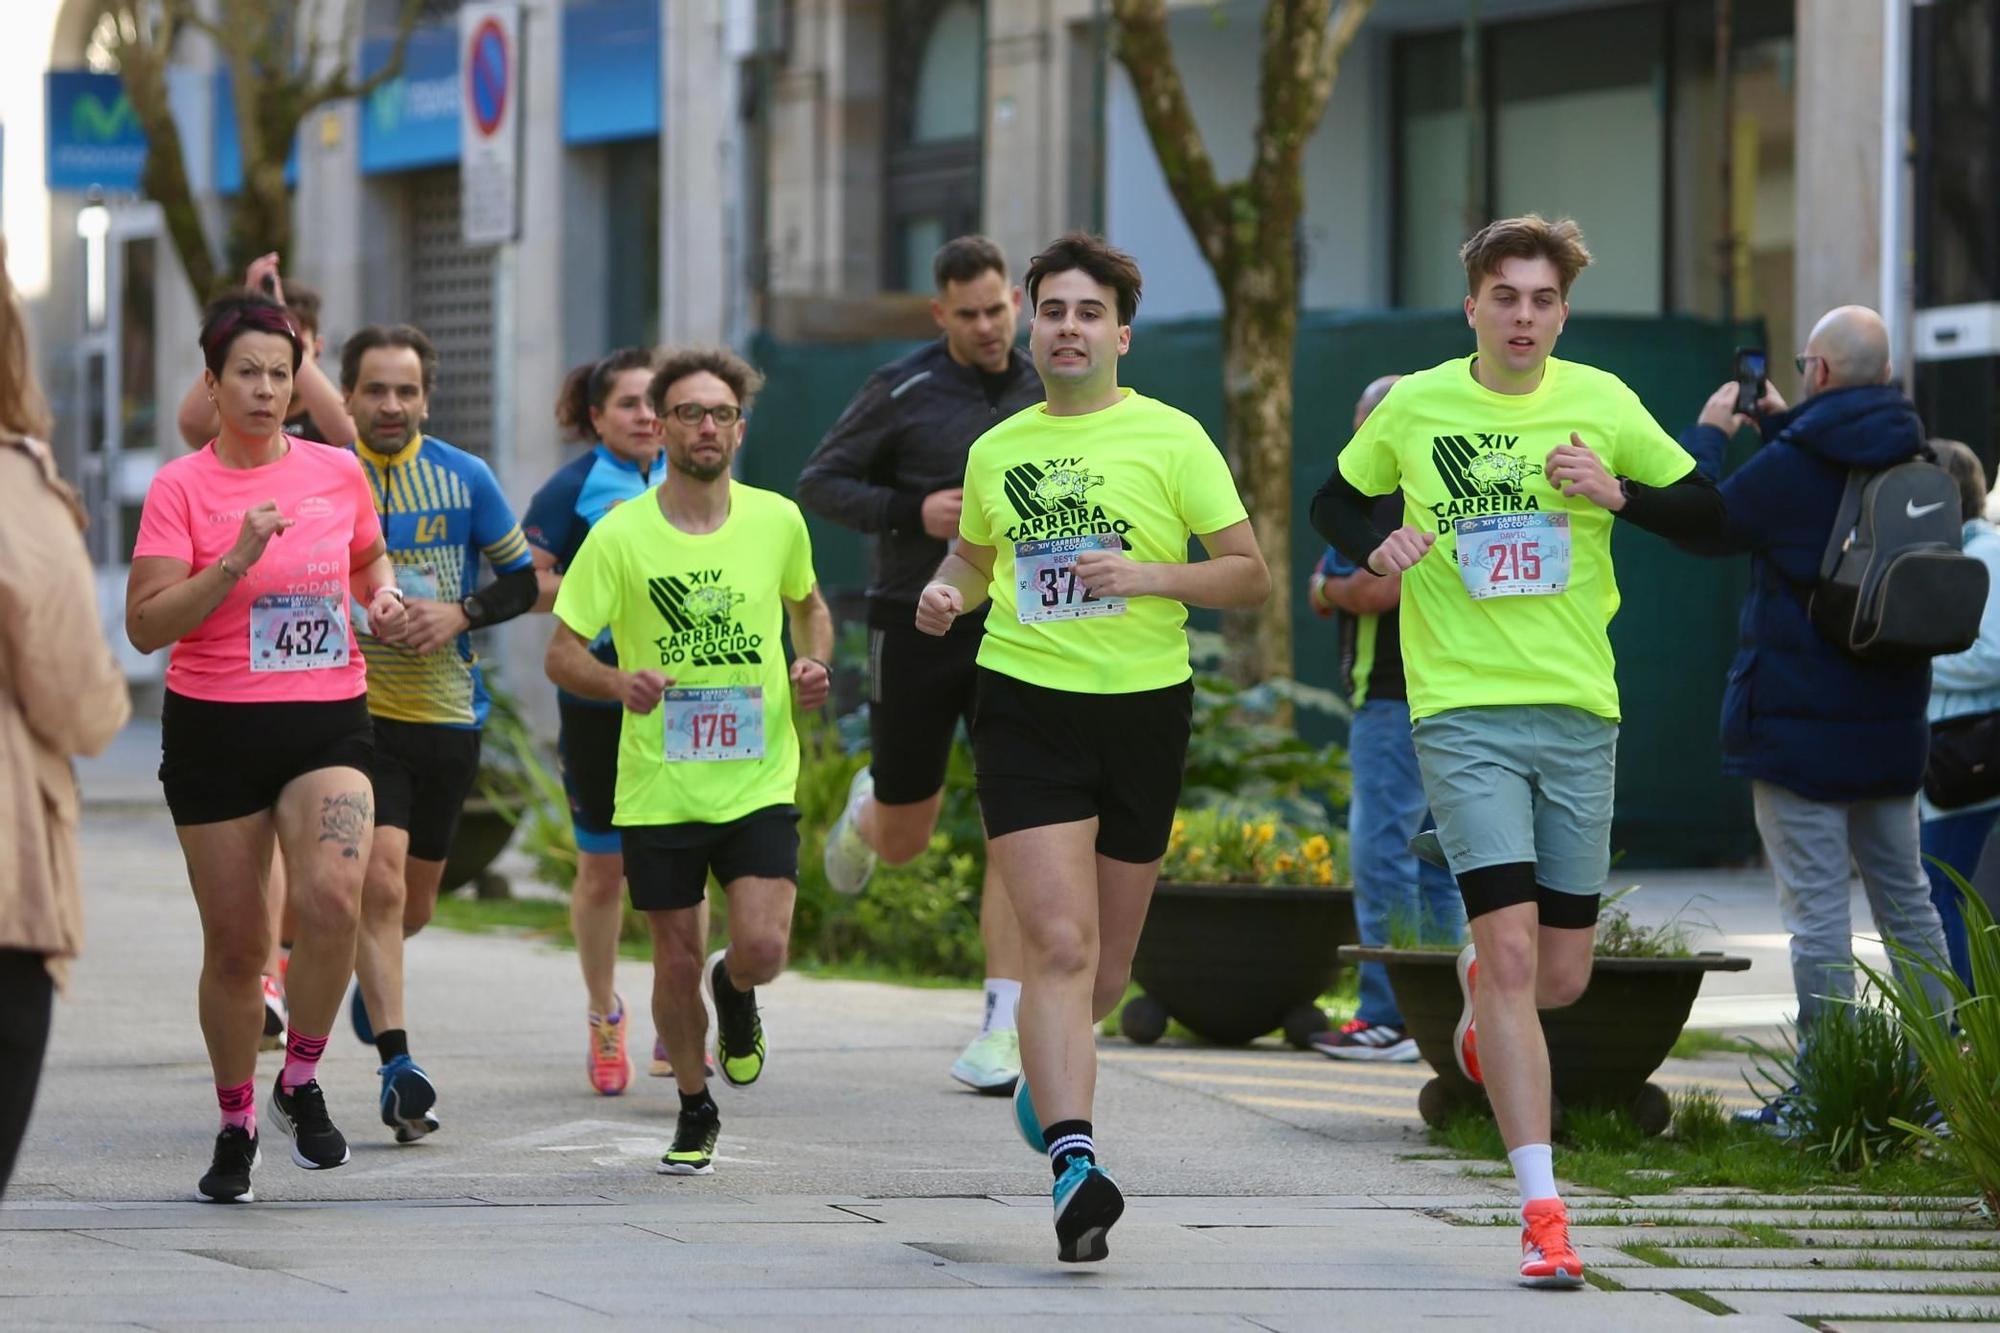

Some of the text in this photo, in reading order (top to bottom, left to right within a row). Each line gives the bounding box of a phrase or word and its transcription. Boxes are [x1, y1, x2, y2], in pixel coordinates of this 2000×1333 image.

[1474, 433, 1519, 449] XIV
[1043, 457, 1084, 470] XIV
[1427, 495, 1540, 518] CARREIRA
[1004, 505, 1107, 542] CARREIRA
[1497, 514, 1534, 523] CARREIRA
[1497, 519, 1541, 530] DO COCIDO
[415, 514, 448, 543] LA
[1500, 531, 1527, 540] DAVID
[1038, 541, 1050, 550] XIV
[1051, 536, 1086, 548] CARREIRA
[1051, 541, 1095, 553] DO COCIDO
[307, 561, 340, 576] POR
[1488, 542, 1541, 582] 215
[686, 568, 722, 585] XIV
[286, 579, 340, 595] TODAS
[275, 619, 329, 656] 432
[653, 622, 744, 650] CARREIRA
[661, 634, 763, 666] DO COCIDO
[692, 713, 737, 749] 176
